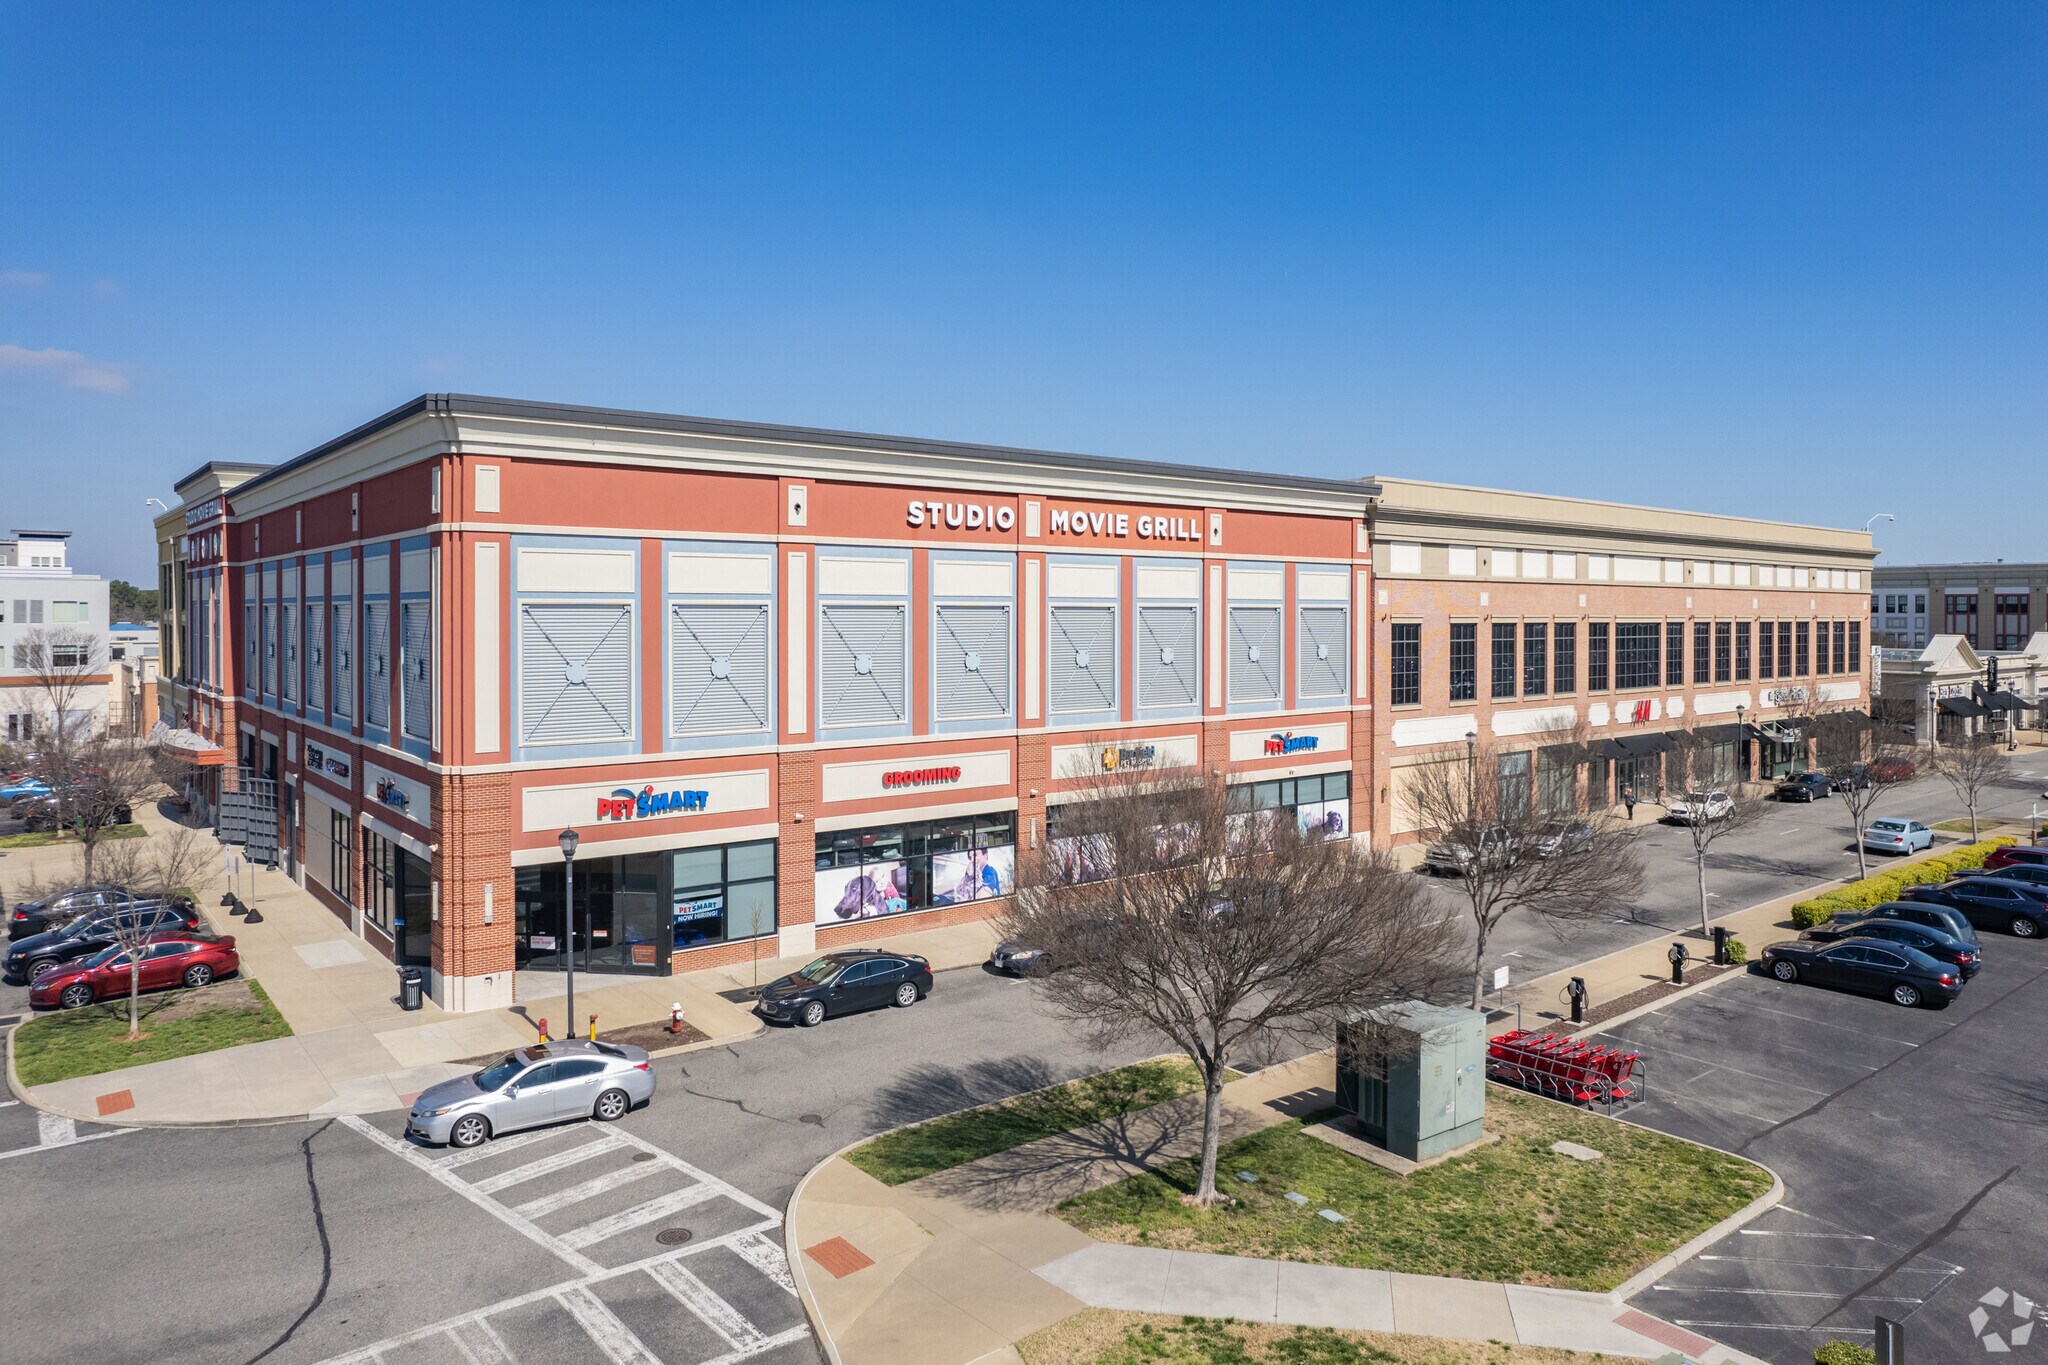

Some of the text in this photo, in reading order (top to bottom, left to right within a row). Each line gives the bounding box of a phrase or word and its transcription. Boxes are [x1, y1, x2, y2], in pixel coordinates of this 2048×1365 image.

[907, 500, 1201, 542] STUDIO MOVIE GRILL
[1264, 735, 1319, 754] PETSMART
[883, 766, 961, 788] GROOMING
[597, 788, 709, 820] PETSMART
[677, 910, 718, 922] NOW HIRING!
[679, 901, 717, 913] PETSMART
